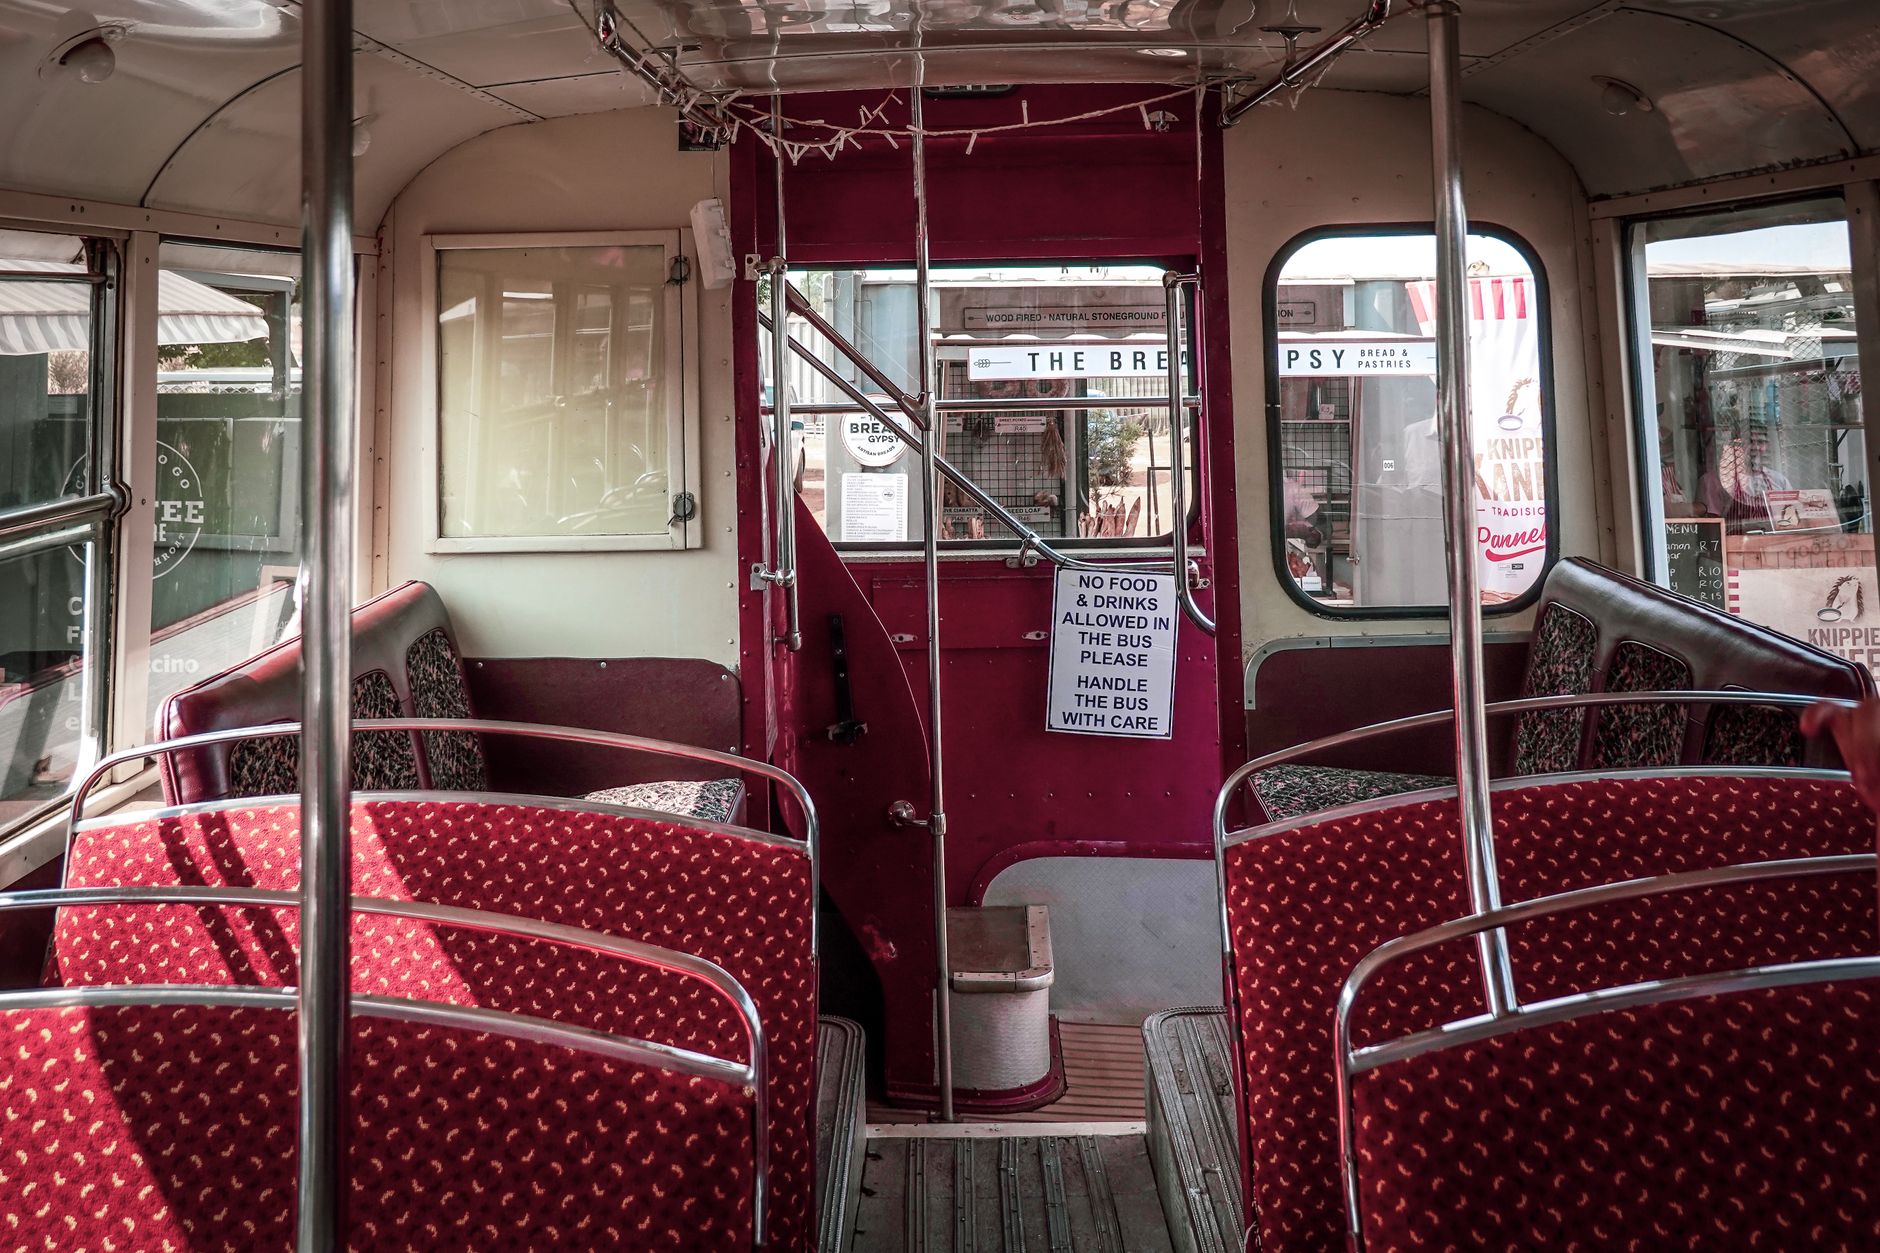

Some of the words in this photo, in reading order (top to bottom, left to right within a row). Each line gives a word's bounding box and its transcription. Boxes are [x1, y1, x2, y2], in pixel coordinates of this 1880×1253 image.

[985, 314, 1014, 322] WOOD
[1016, 313, 1042, 322] FIRED
[1049, 312, 1089, 321] NATURAL
[1091, 311, 1159, 321] STONEGROUND
[1360, 349, 1395, 357] BREAD
[1402, 349, 1408, 357] &
[1027, 352, 1085, 372] THE
[1358, 360, 1411, 368] PASTRIES
[850, 422, 903, 434] BREA
[868, 435, 900, 443] GYPSY
[1665, 523, 1698, 534] MENU
[1079, 575, 1104, 589] NO
[1109, 577, 1158, 592] FOOD
[1076, 594, 1088, 607] &
[1094, 595, 1158, 611] DRINKS
[1062, 611, 1148, 629] ALLOWED
[1153, 617, 1169, 630] IN
[1078, 631, 1111, 646] THE
[1117, 634, 1152, 648] BUS
[1080, 651, 1148, 667] PLEASE
[1077, 675, 1148, 692] HANDLE
[1074, 694, 1107, 708] THE
[1113, 696, 1148, 711] BUS
[1062, 712, 1105, 728] WITH
[1111, 715, 1158, 730] CARE
